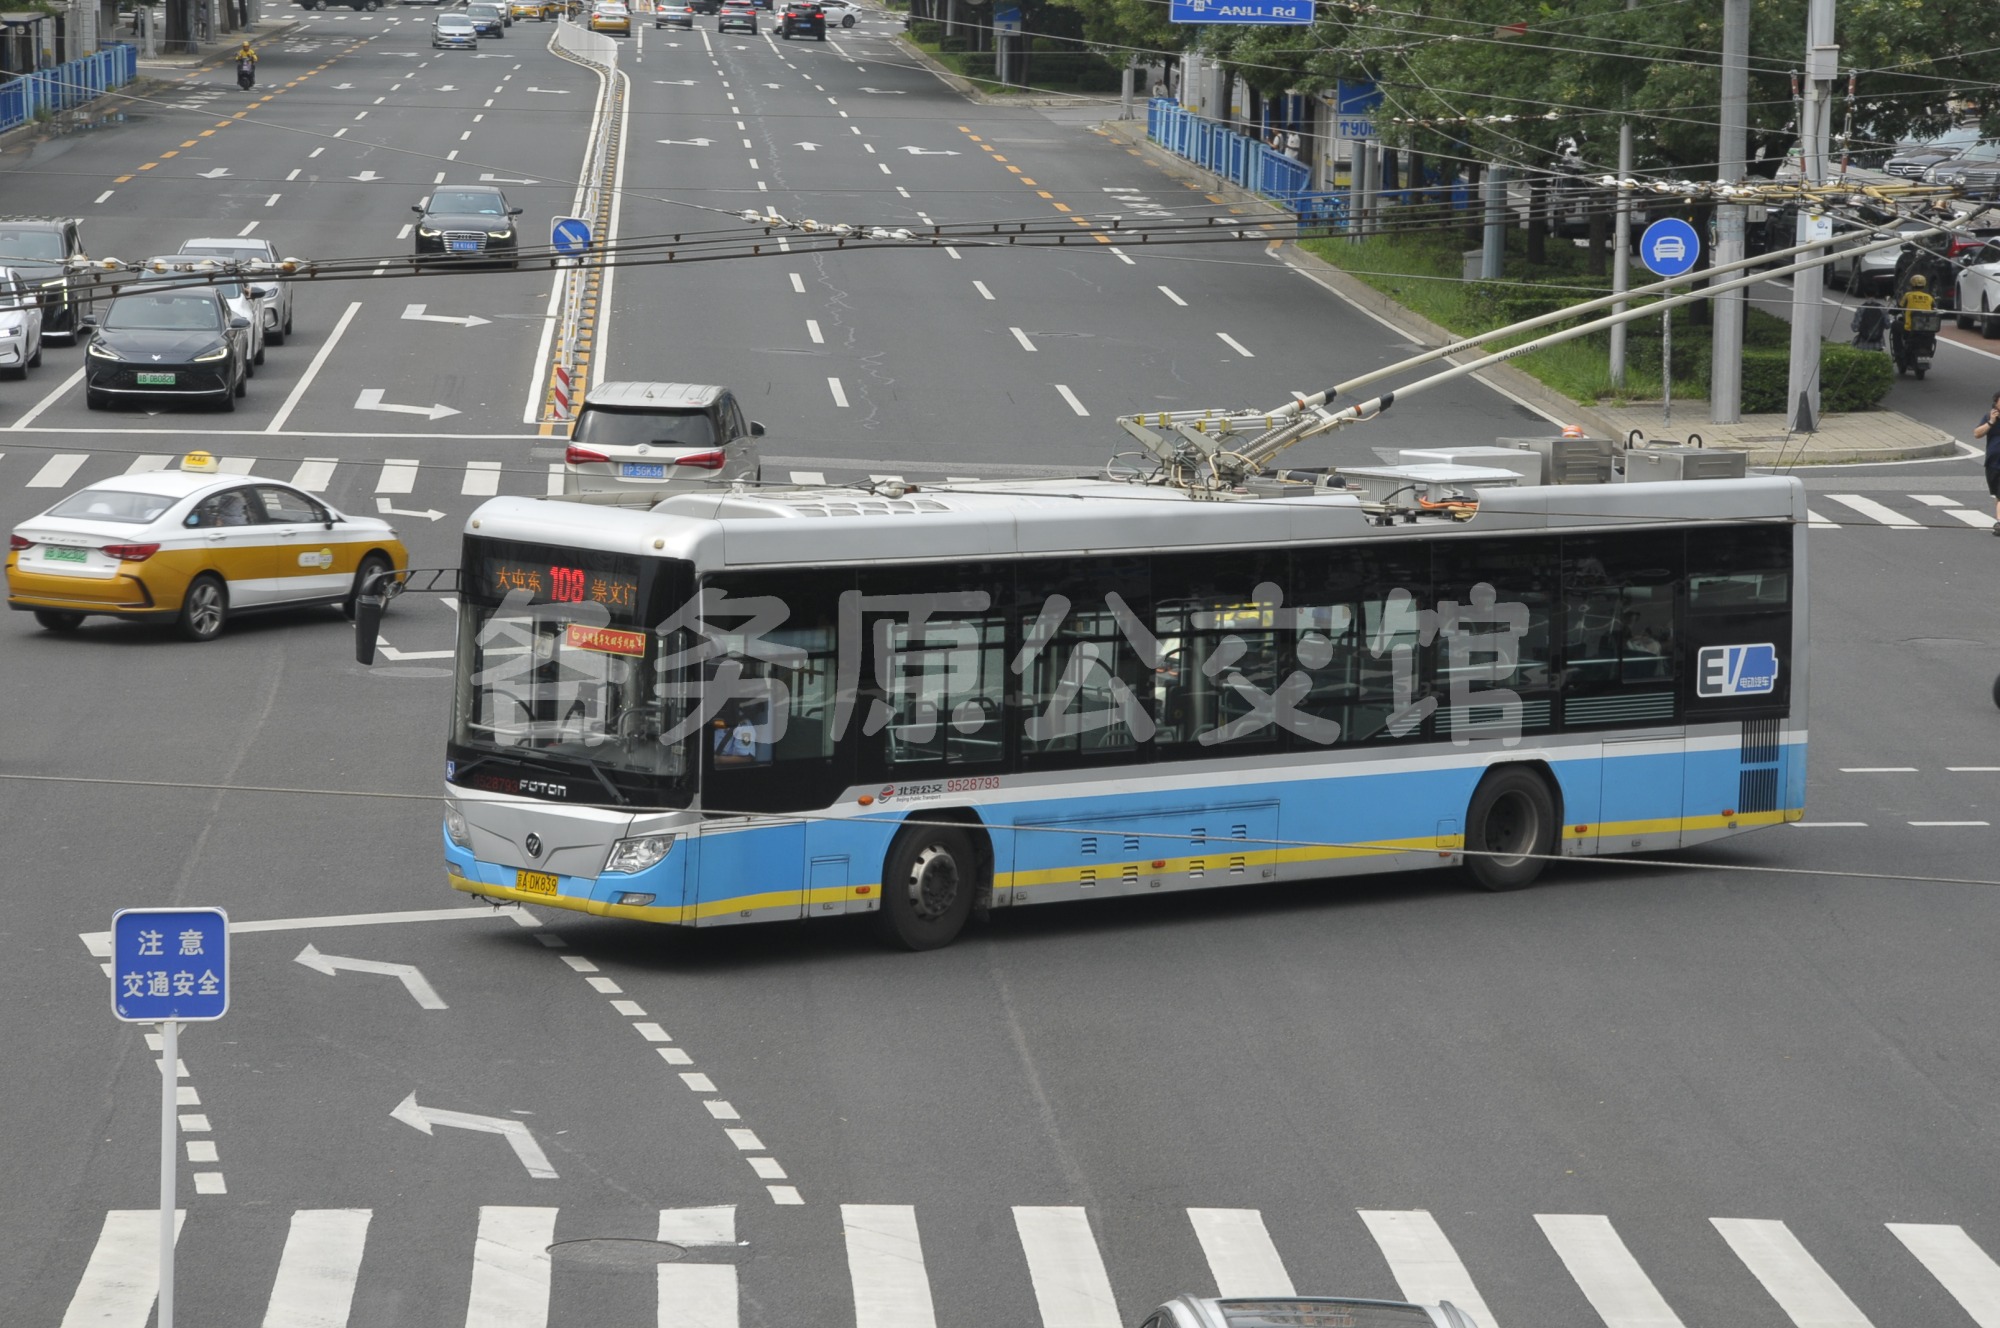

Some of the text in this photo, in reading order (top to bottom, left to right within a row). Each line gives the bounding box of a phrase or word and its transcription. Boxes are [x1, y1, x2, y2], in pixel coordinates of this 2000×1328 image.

[1219, 6, 1297, 17] ANLI Rd
[496, 566, 637, 606] 大屯东 108 崇文门
[519, 780, 566, 797] FOTON
[897, 776, 1000, 796] 北京公交 9528793
[138, 929, 204, 956] 注意
[123, 969, 220, 998] 交通安全
